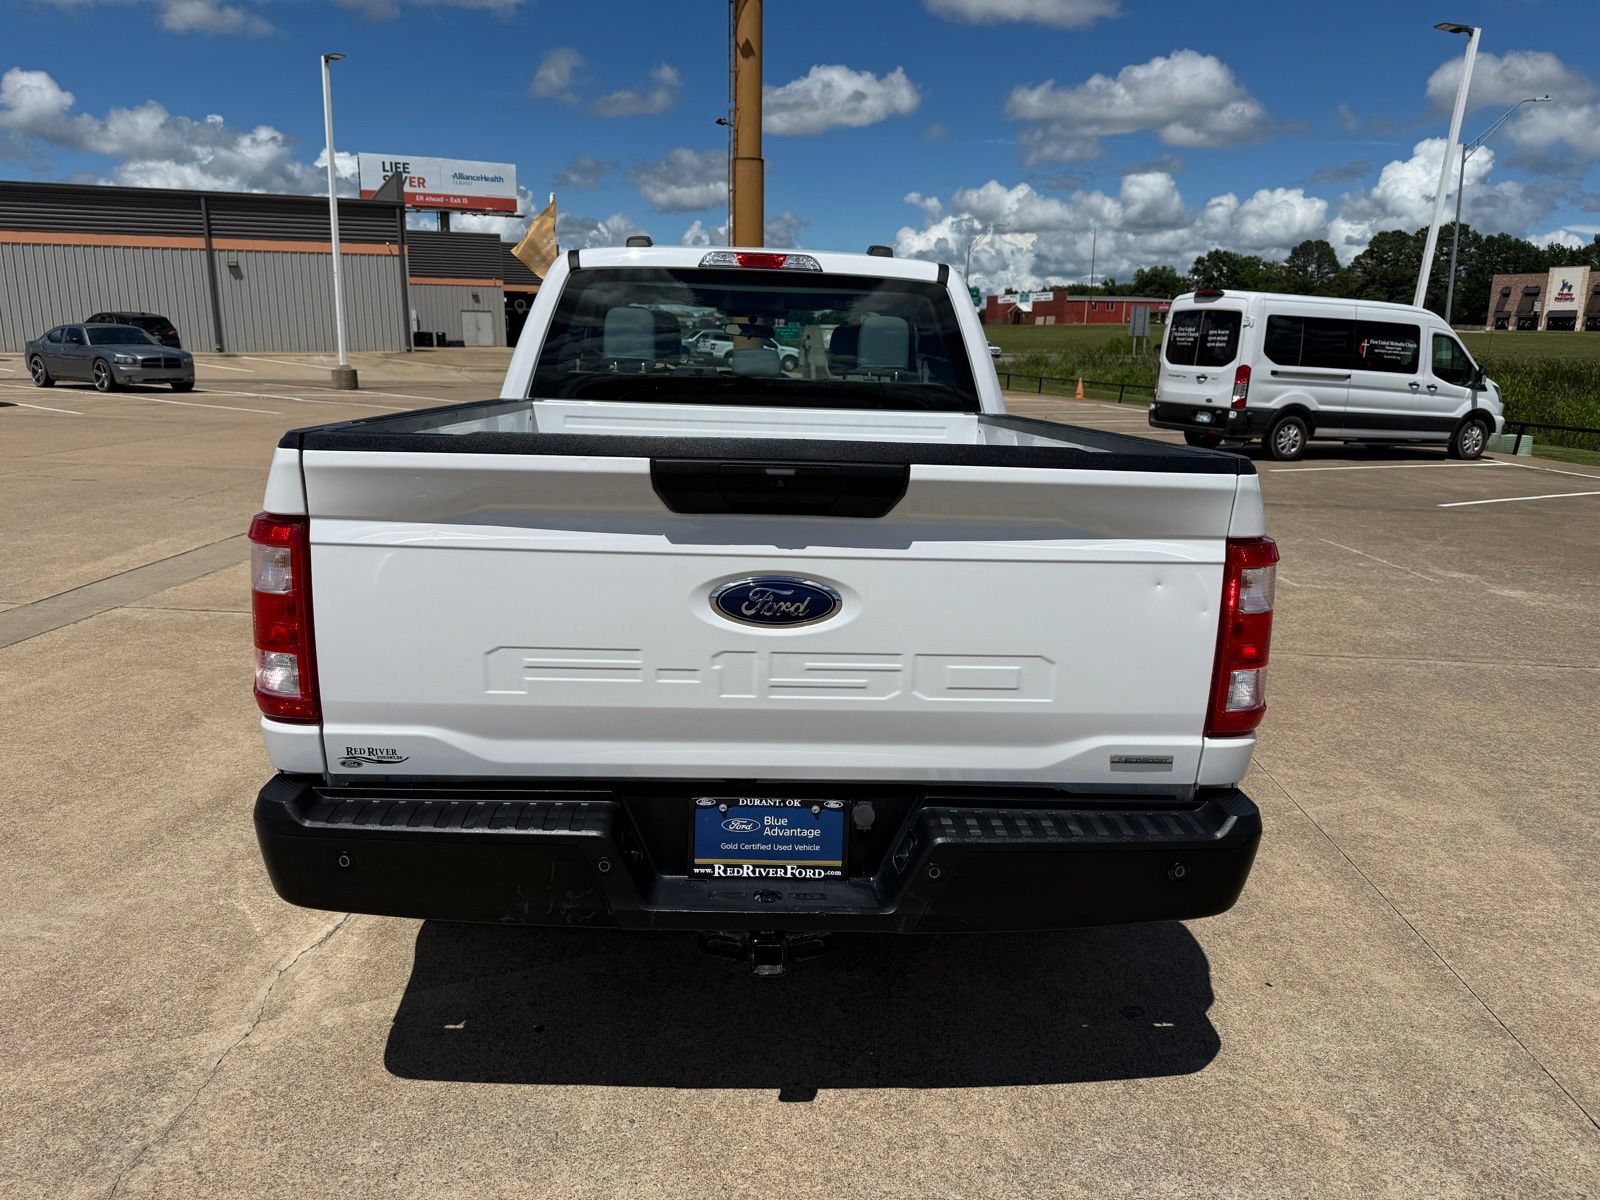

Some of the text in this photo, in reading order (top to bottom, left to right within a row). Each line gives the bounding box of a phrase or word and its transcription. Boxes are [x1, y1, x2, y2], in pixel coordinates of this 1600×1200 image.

[382, 161, 410, 174] LIFE
[382, 174, 426, 188] SVER
[452, 172, 504, 185] AllianceHealth
[415, 194, 424, 202] ER
[425, 195, 444, 203] Ahead
[741, 587, 811, 617] Ford
[483, 646, 1056, 702] F-150
[346, 747, 397, 756] RED RIVER
[738, 798, 802, 807] DURANT, OK
[764, 816, 788, 826] Blue
[763, 827, 821, 839] Advantage
[720, 842, 821, 851] Gold Certified Used Vehicle
